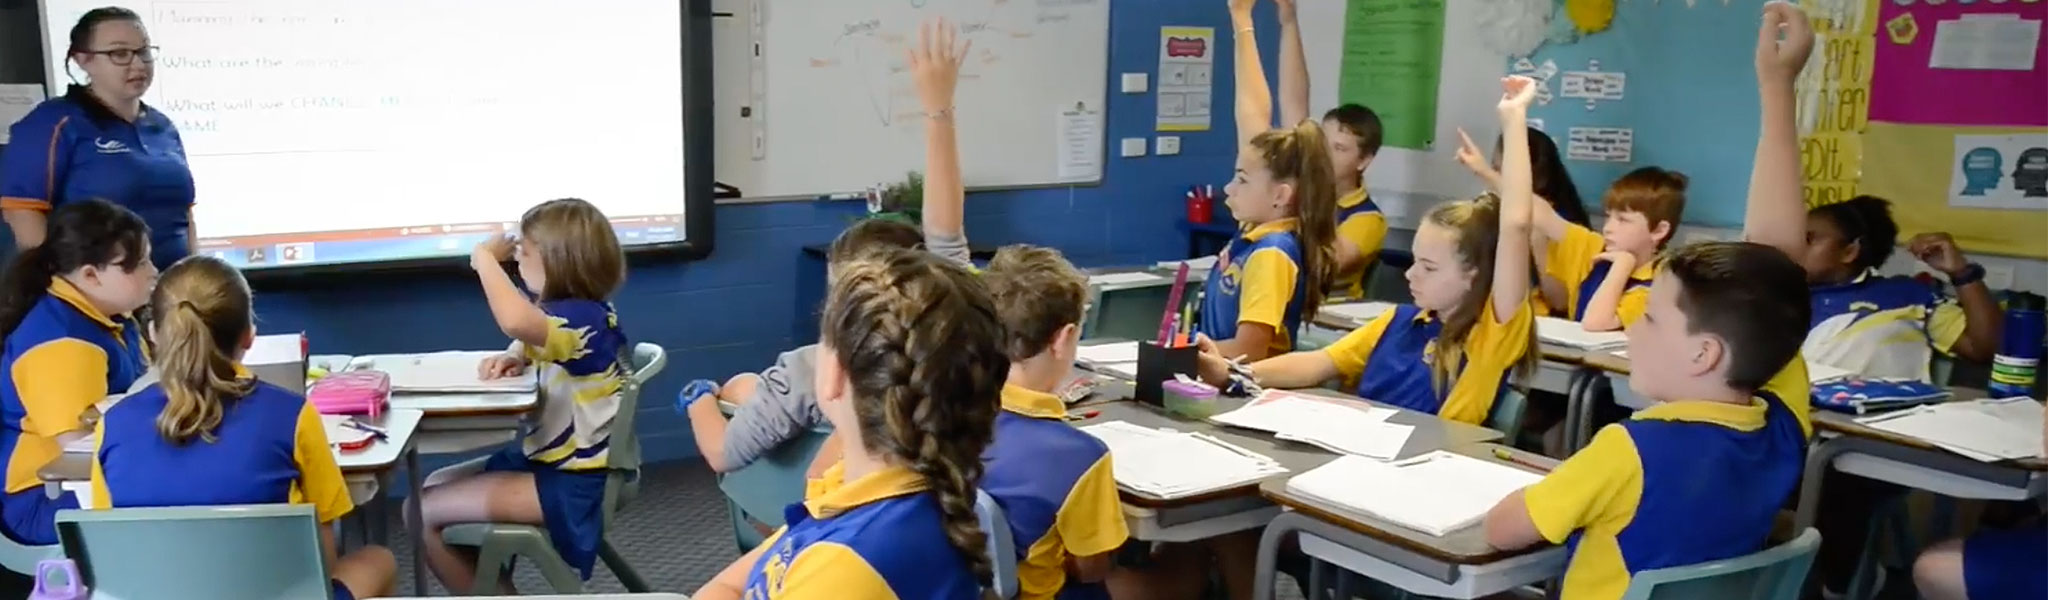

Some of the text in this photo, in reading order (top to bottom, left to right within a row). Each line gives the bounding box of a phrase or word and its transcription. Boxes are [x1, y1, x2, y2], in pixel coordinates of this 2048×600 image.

[162, 56, 212, 70] What
[255, 56, 284, 70] the
[166, 99, 216, 112] What
[223, 97, 253, 111] will
[176, 119, 219, 132] AME
